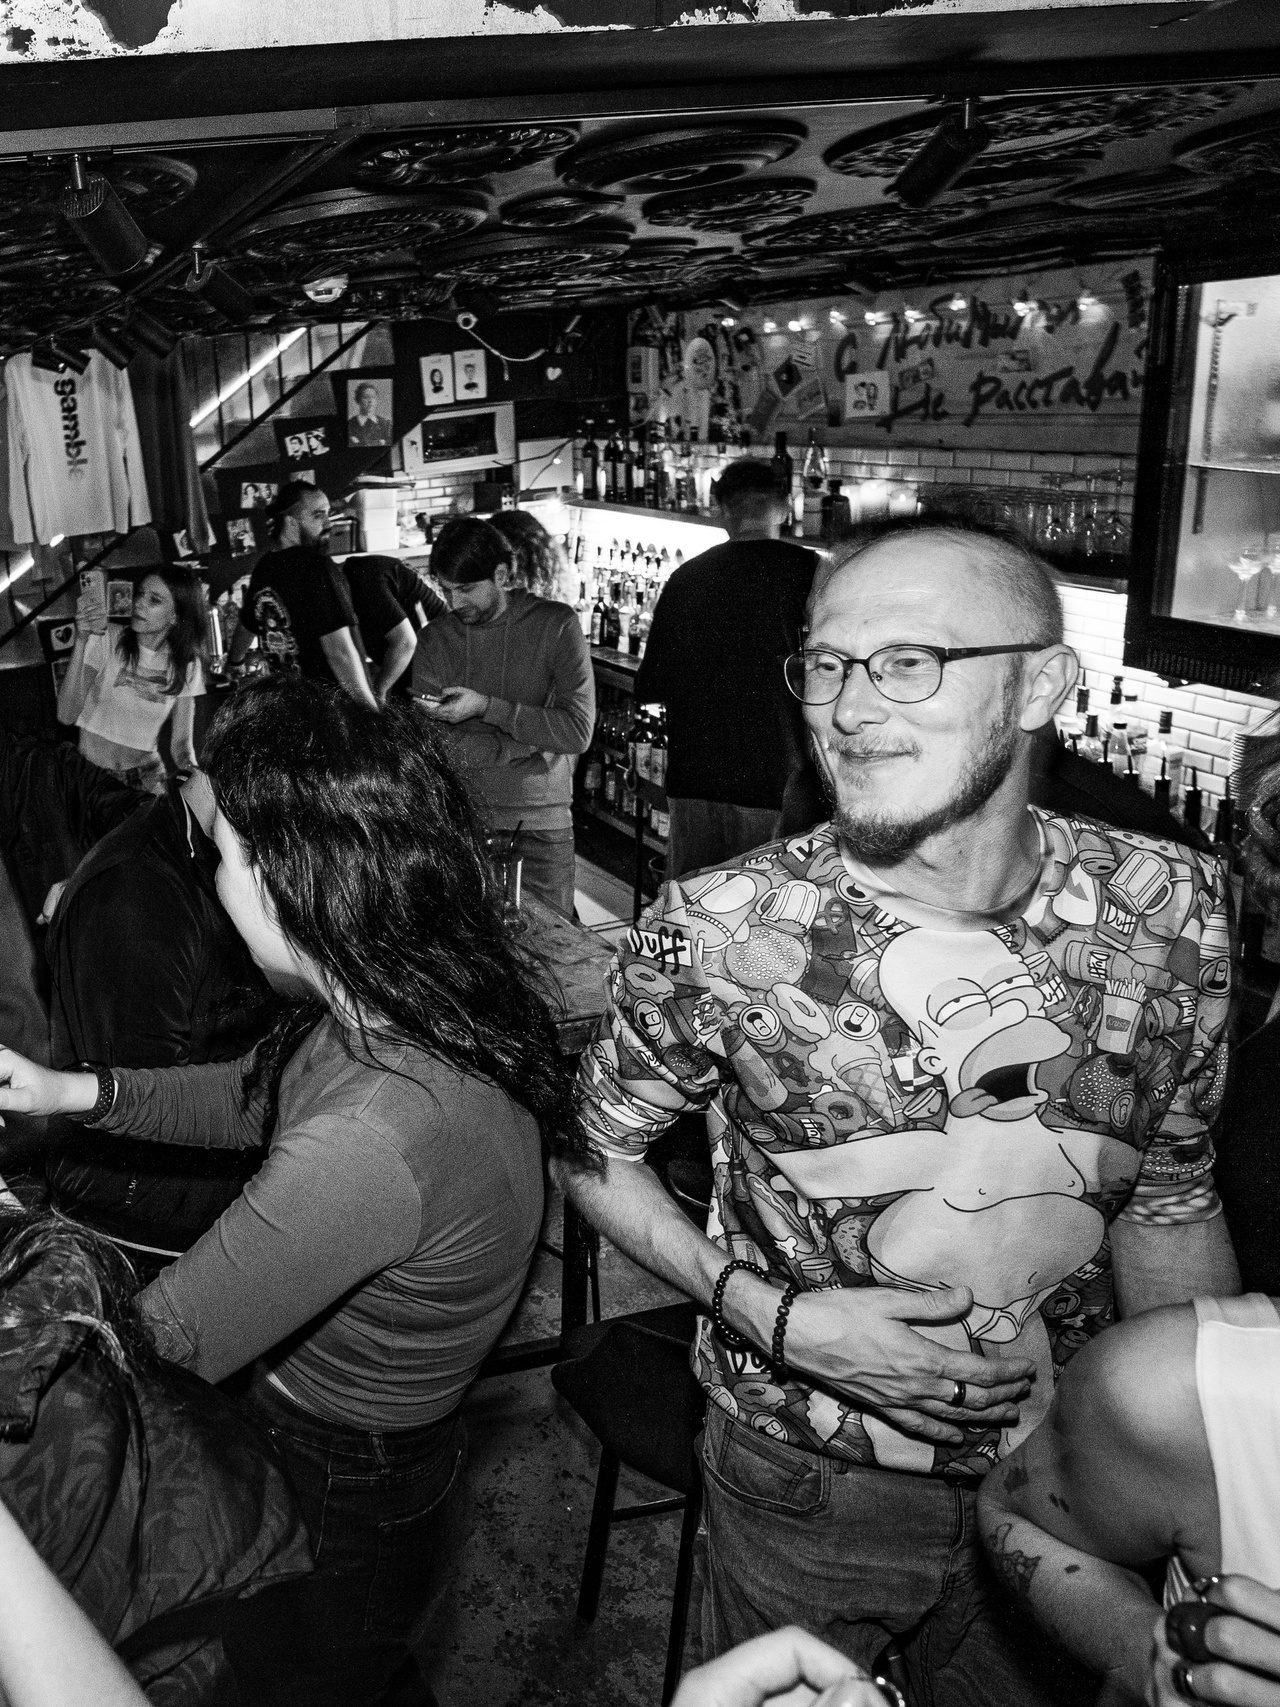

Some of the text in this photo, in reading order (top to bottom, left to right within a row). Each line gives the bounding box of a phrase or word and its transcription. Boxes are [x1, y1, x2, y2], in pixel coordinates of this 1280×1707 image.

[1103, 898, 1136, 936] Duff
[630, 923, 687, 976] Duff
[1088, 949, 1110, 978] Duff
[1044, 973, 1067, 1006] uff
